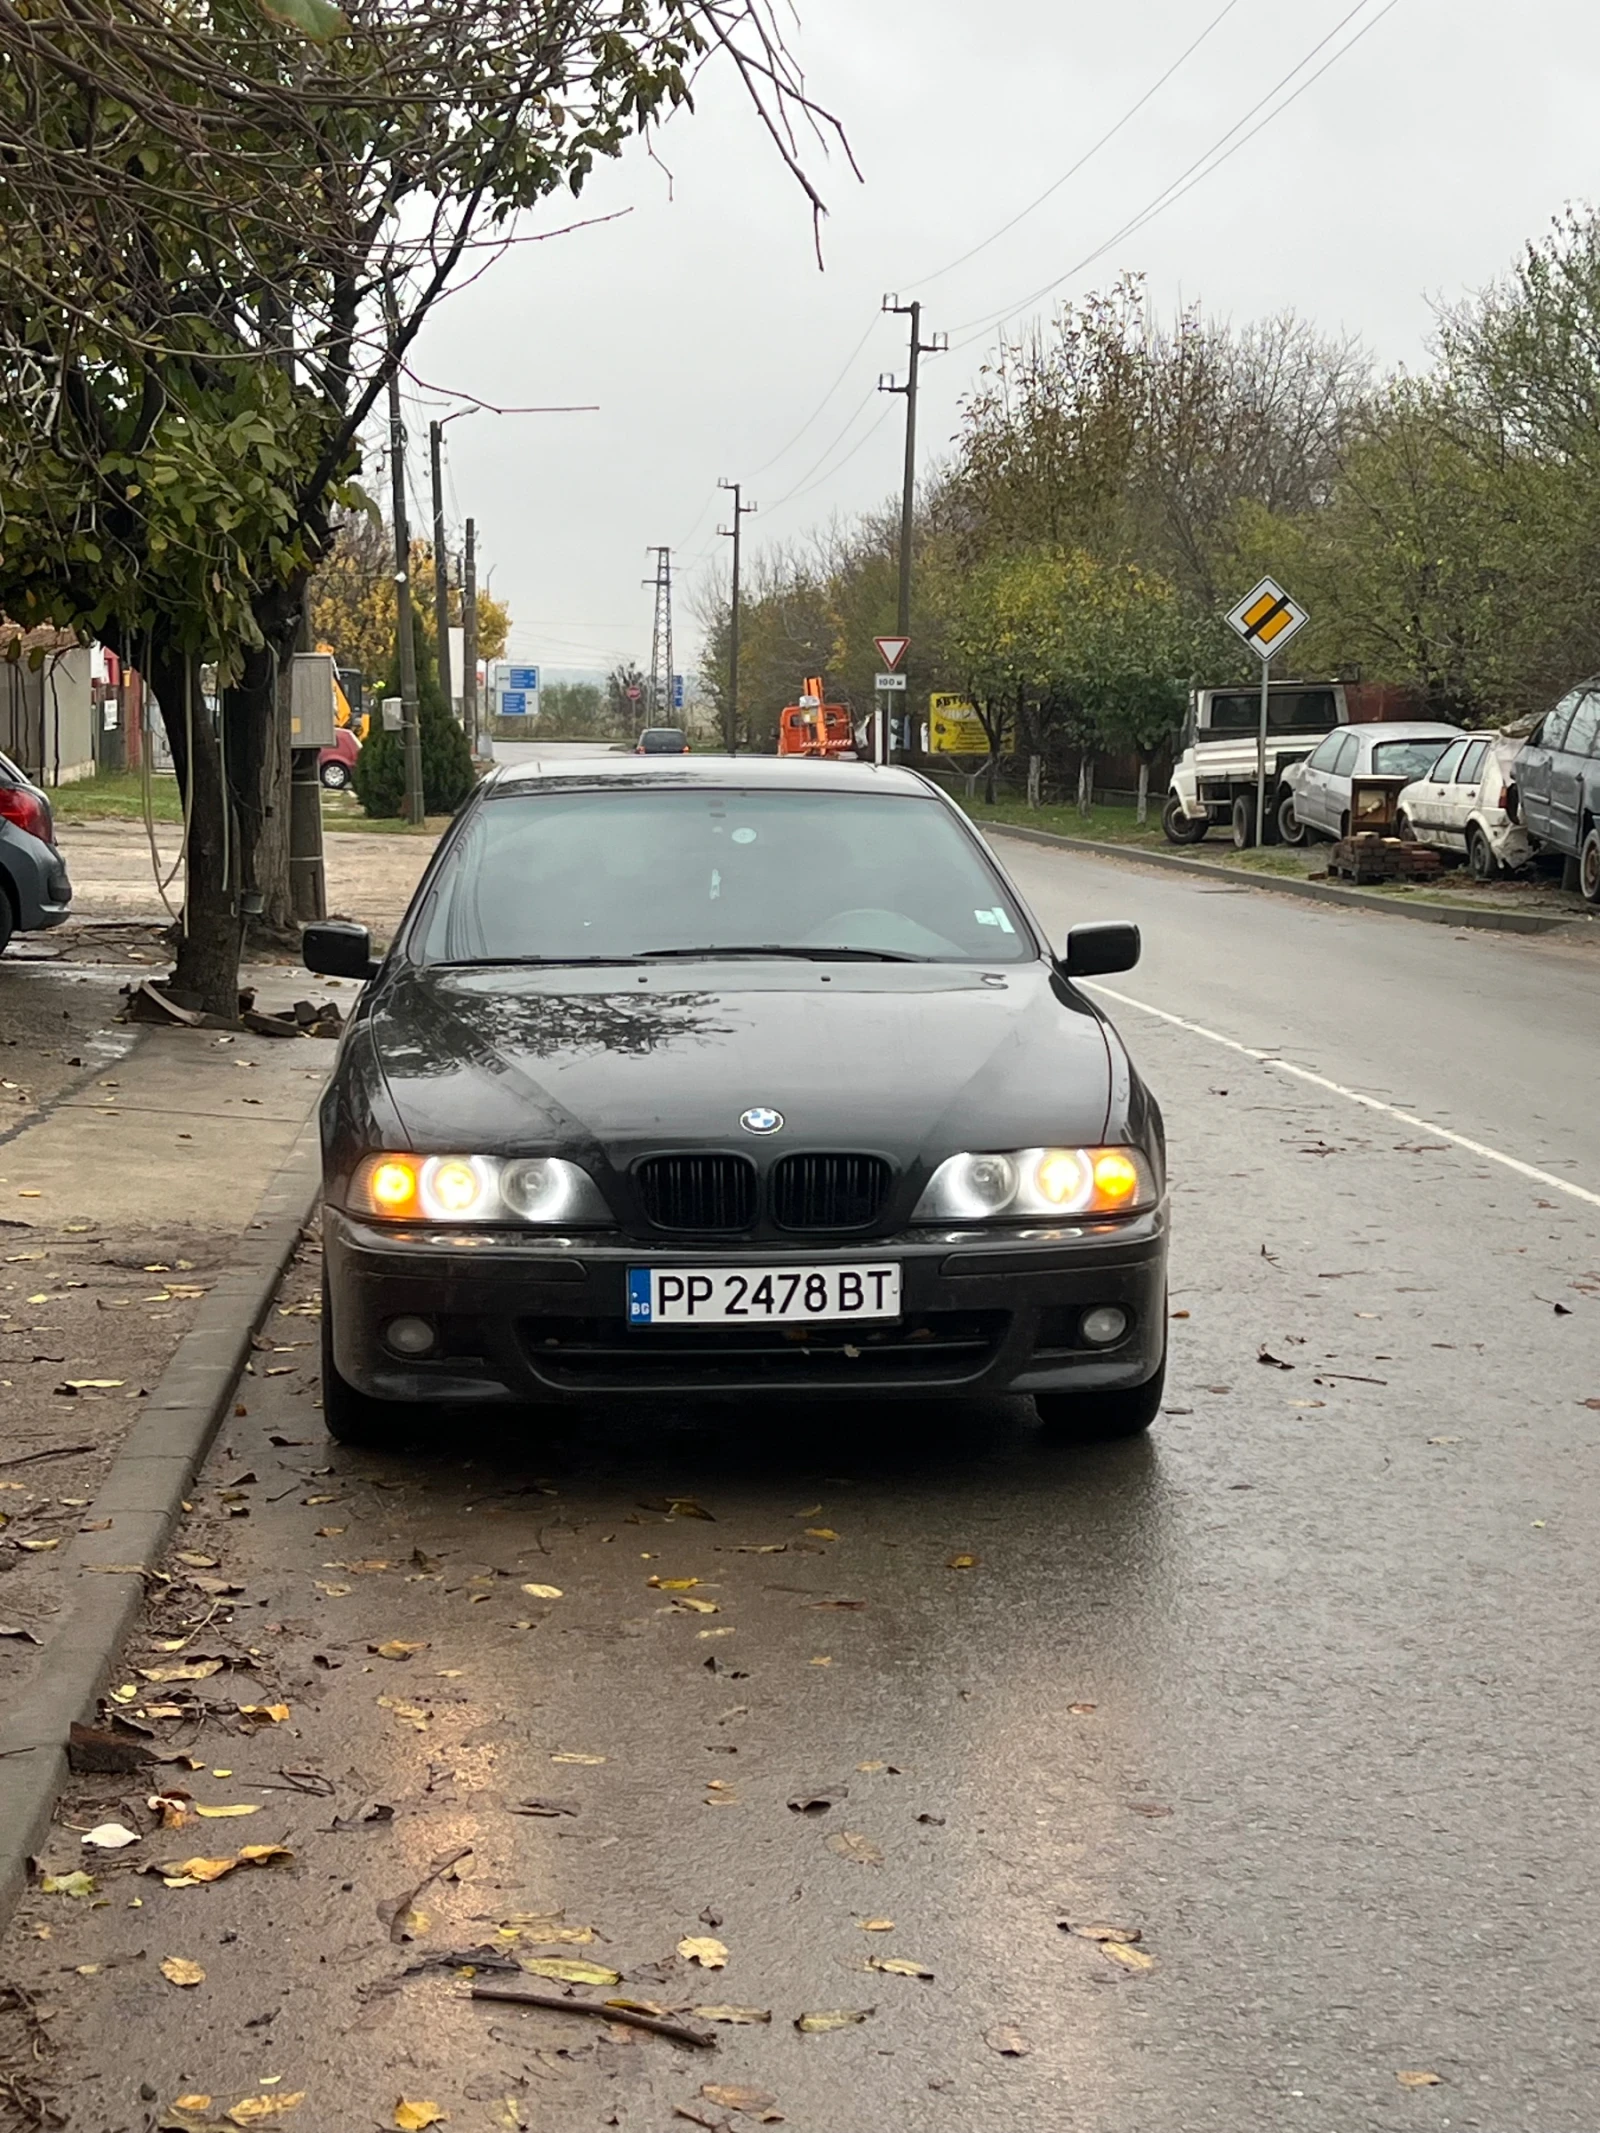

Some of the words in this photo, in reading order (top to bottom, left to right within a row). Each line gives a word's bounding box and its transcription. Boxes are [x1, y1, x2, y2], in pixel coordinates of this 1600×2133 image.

[879, 678, 895, 686] 100
[658, 1275, 713, 1315] PP
[724, 1273, 828, 1314] 2478
[838, 1271, 893, 1312] BT
[632, 1302, 650, 1315] BG
